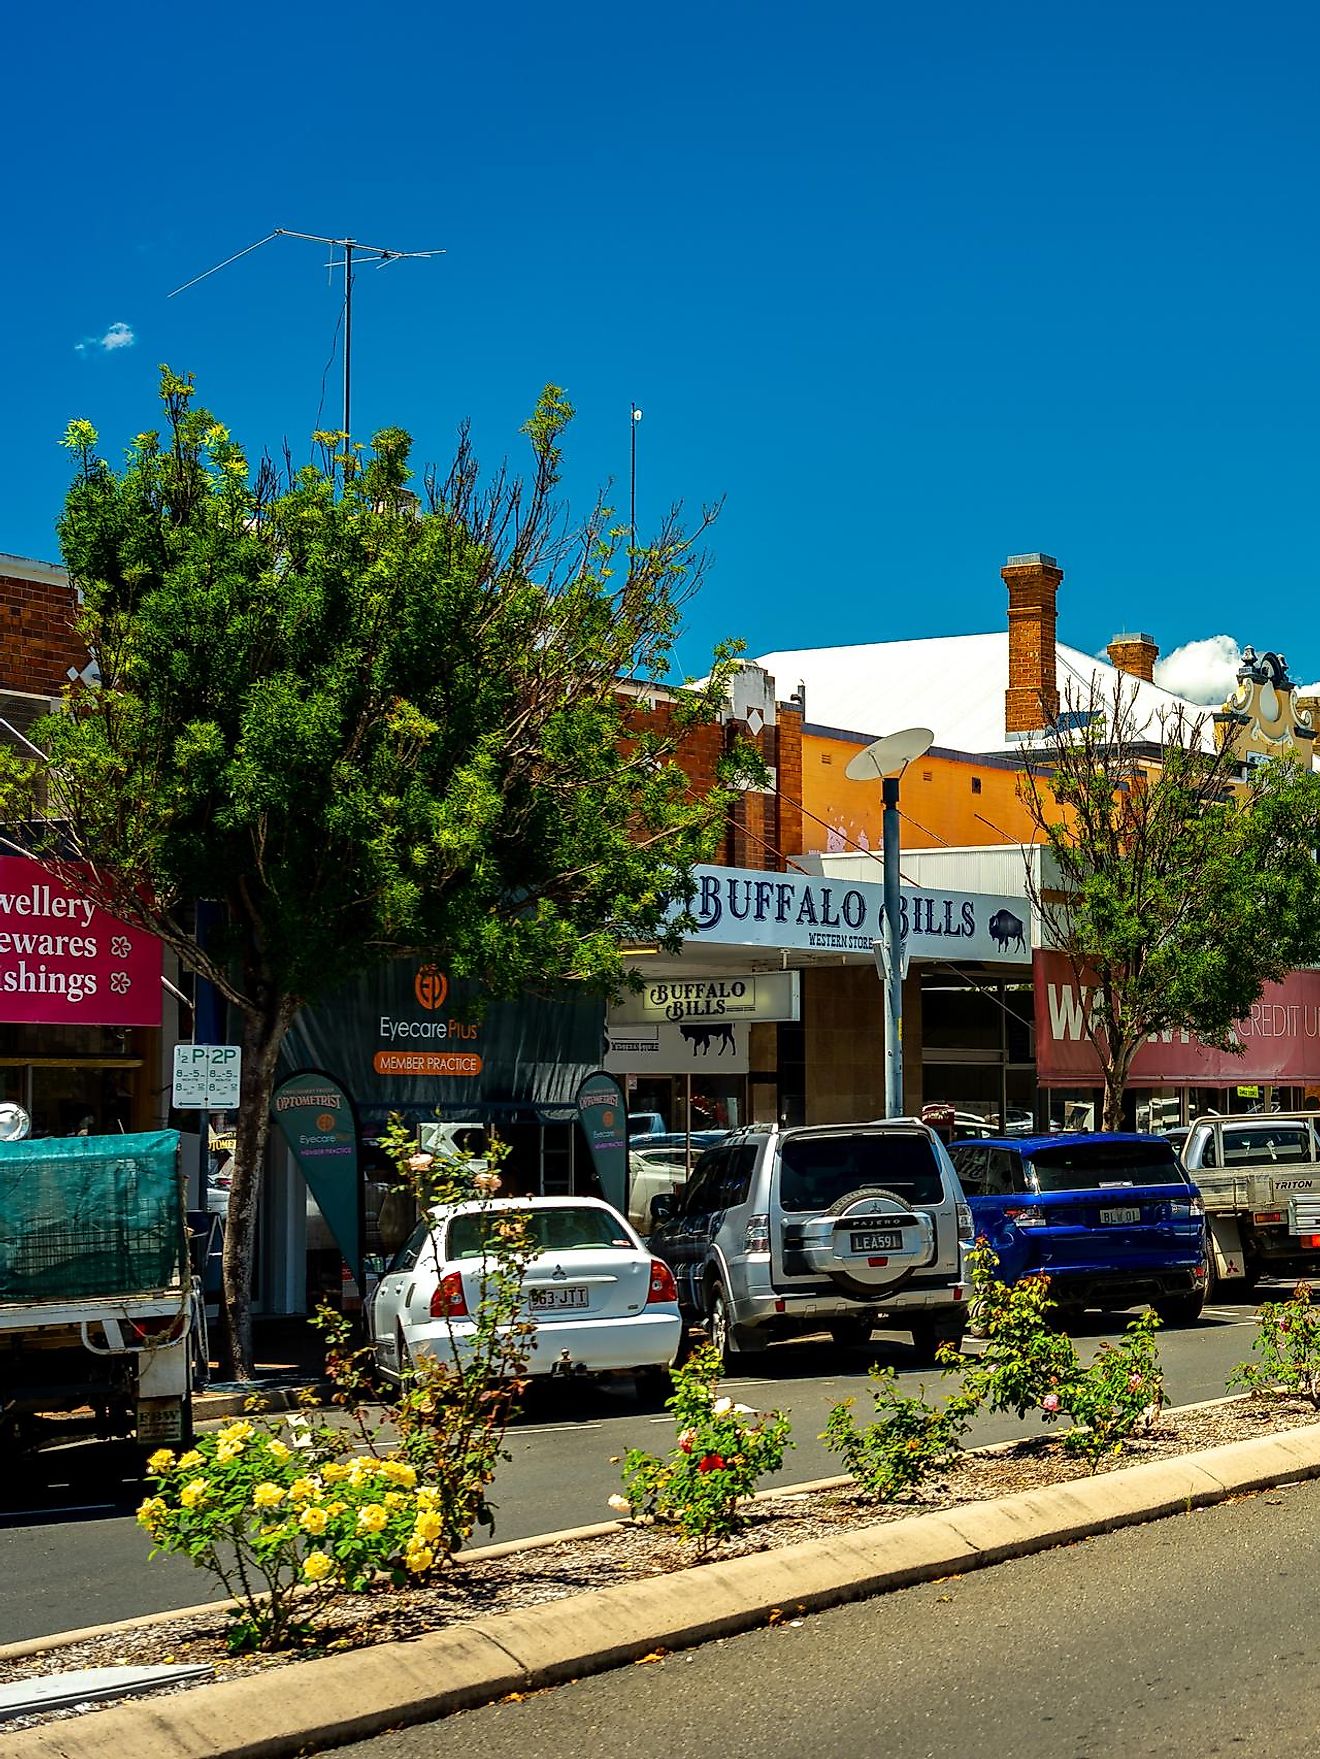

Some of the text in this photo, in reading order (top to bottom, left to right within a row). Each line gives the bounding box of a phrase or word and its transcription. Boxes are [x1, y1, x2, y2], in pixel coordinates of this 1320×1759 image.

[691, 874, 868, 932] BUFFALO
[808, 932, 874, 950] WESTERN STORE
[650, 981, 745, 1005] BUFFALO
[665, 999, 726, 1022] BILLS
[1238, 1004, 1300, 1037] CREDIT
[211, 1048, 237, 1064] 2P
[380, 1056, 478, 1071] MEMBER PRACTICE
[276, 1094, 341, 1112] OPTOMETRIST
[1275, 1180, 1313, 1190] TRITON
[855, 1235, 897, 1250] LEA591
